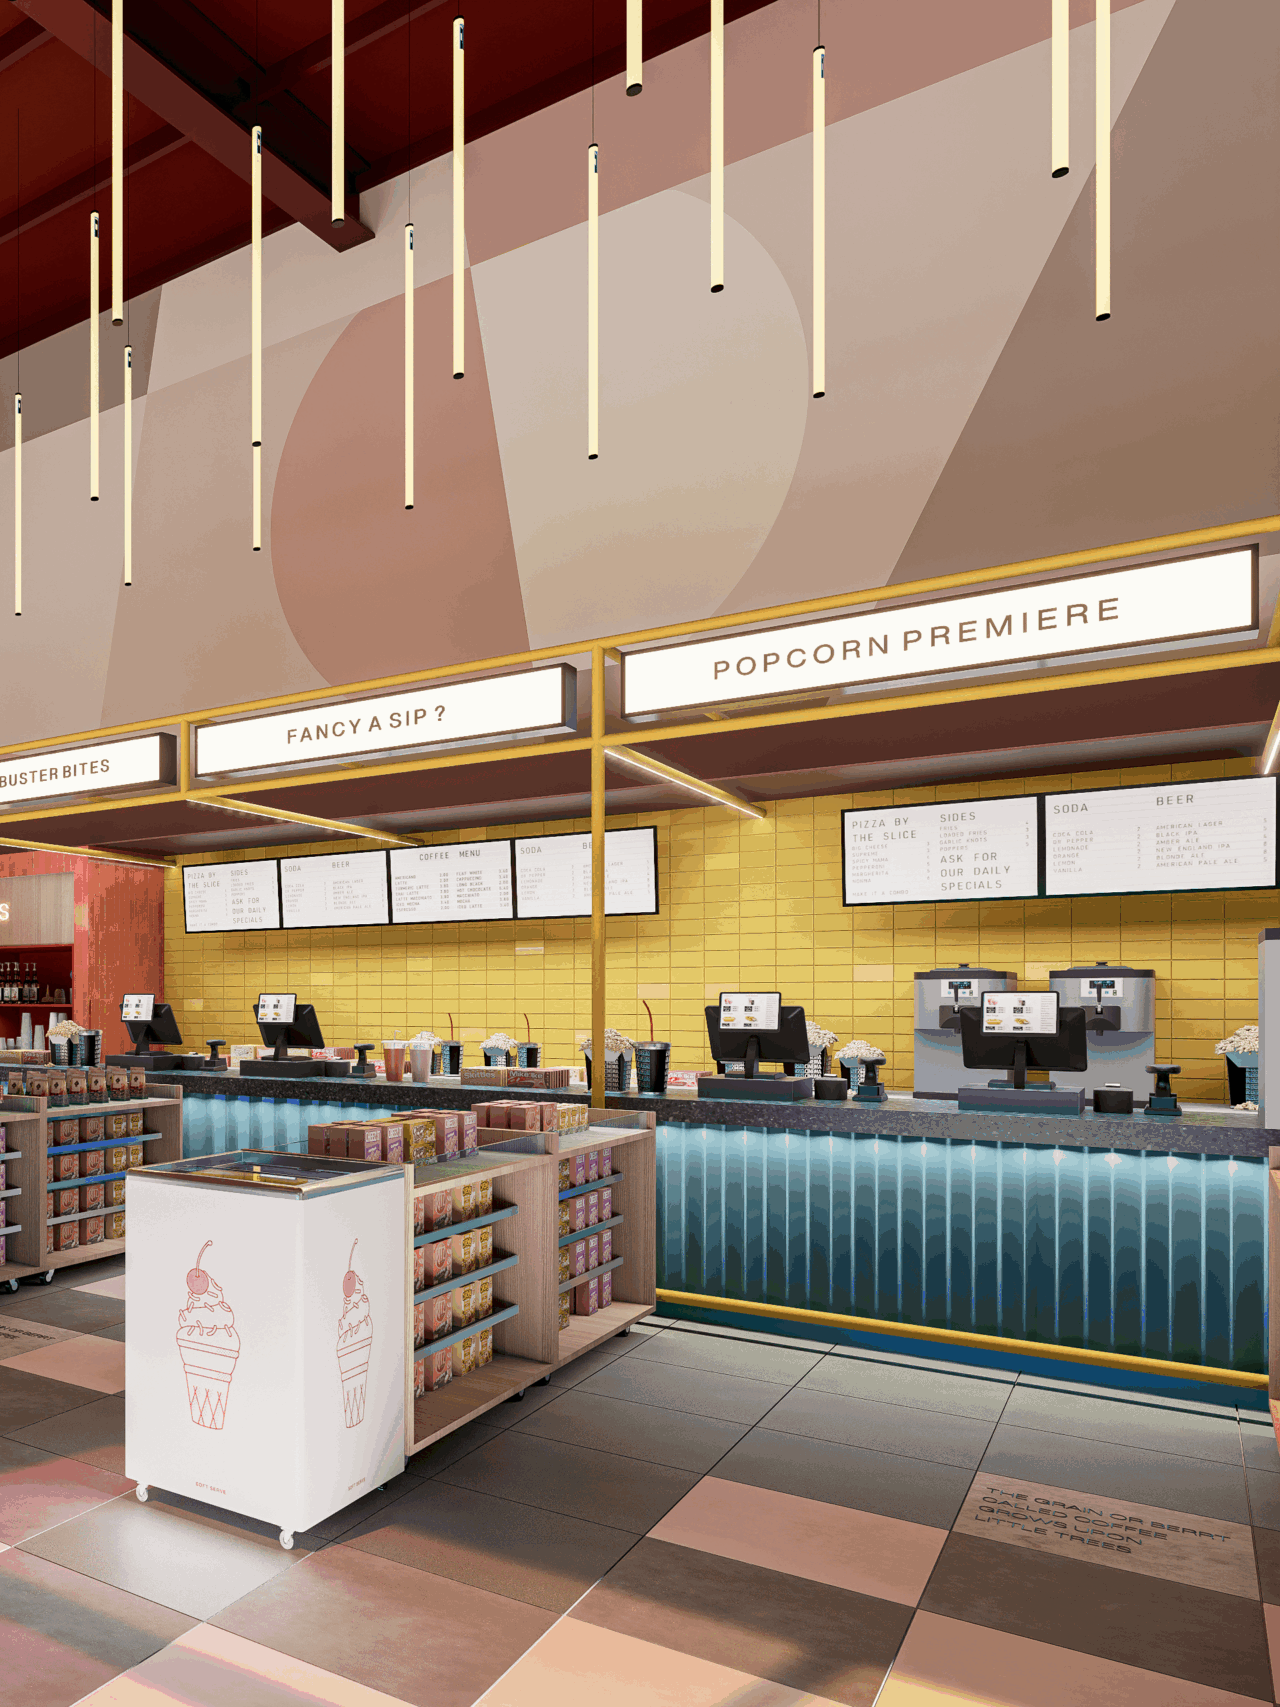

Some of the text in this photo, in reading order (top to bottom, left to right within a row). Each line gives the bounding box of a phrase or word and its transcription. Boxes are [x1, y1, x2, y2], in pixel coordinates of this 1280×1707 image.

[713, 597, 1119, 681] POPCORN PREMIERE
[287, 705, 446, 744] FANCY A SIP ?
[62, 759, 110, 778] BITES
[1156, 794, 1194, 806] BEER
[1053, 803, 1089, 814] SODA
[940, 811, 976, 823] SIDES
[852, 817, 909, 830] PIZZA BY
[852, 830, 917, 843] THE SLICE
[520, 846, 542, 854] SODA
[1052, 844, 1089, 852] LEMONADE
[419, 849, 481, 861] COFFEE MENU
[940, 852, 997, 864] ASK FOR
[940, 865, 1010, 878] OUR DAILY
[941, 880, 1002, 891] SPECIALS
[464, 1071, 496, 1079] Skittles
[210, 1486, 226, 1495] SERVE
[986, 1487, 1029, 1502] THE
[1034, 1498, 1104, 1517] GRAIN
[1109, 1512, 1144, 1525] OR
[982, 1496, 1168, 1540] CALLED COFFEE
[978, 1505, 1143, 1545] GROWS UPON
[974, 1514, 1133, 1554] LITTLE TREES
